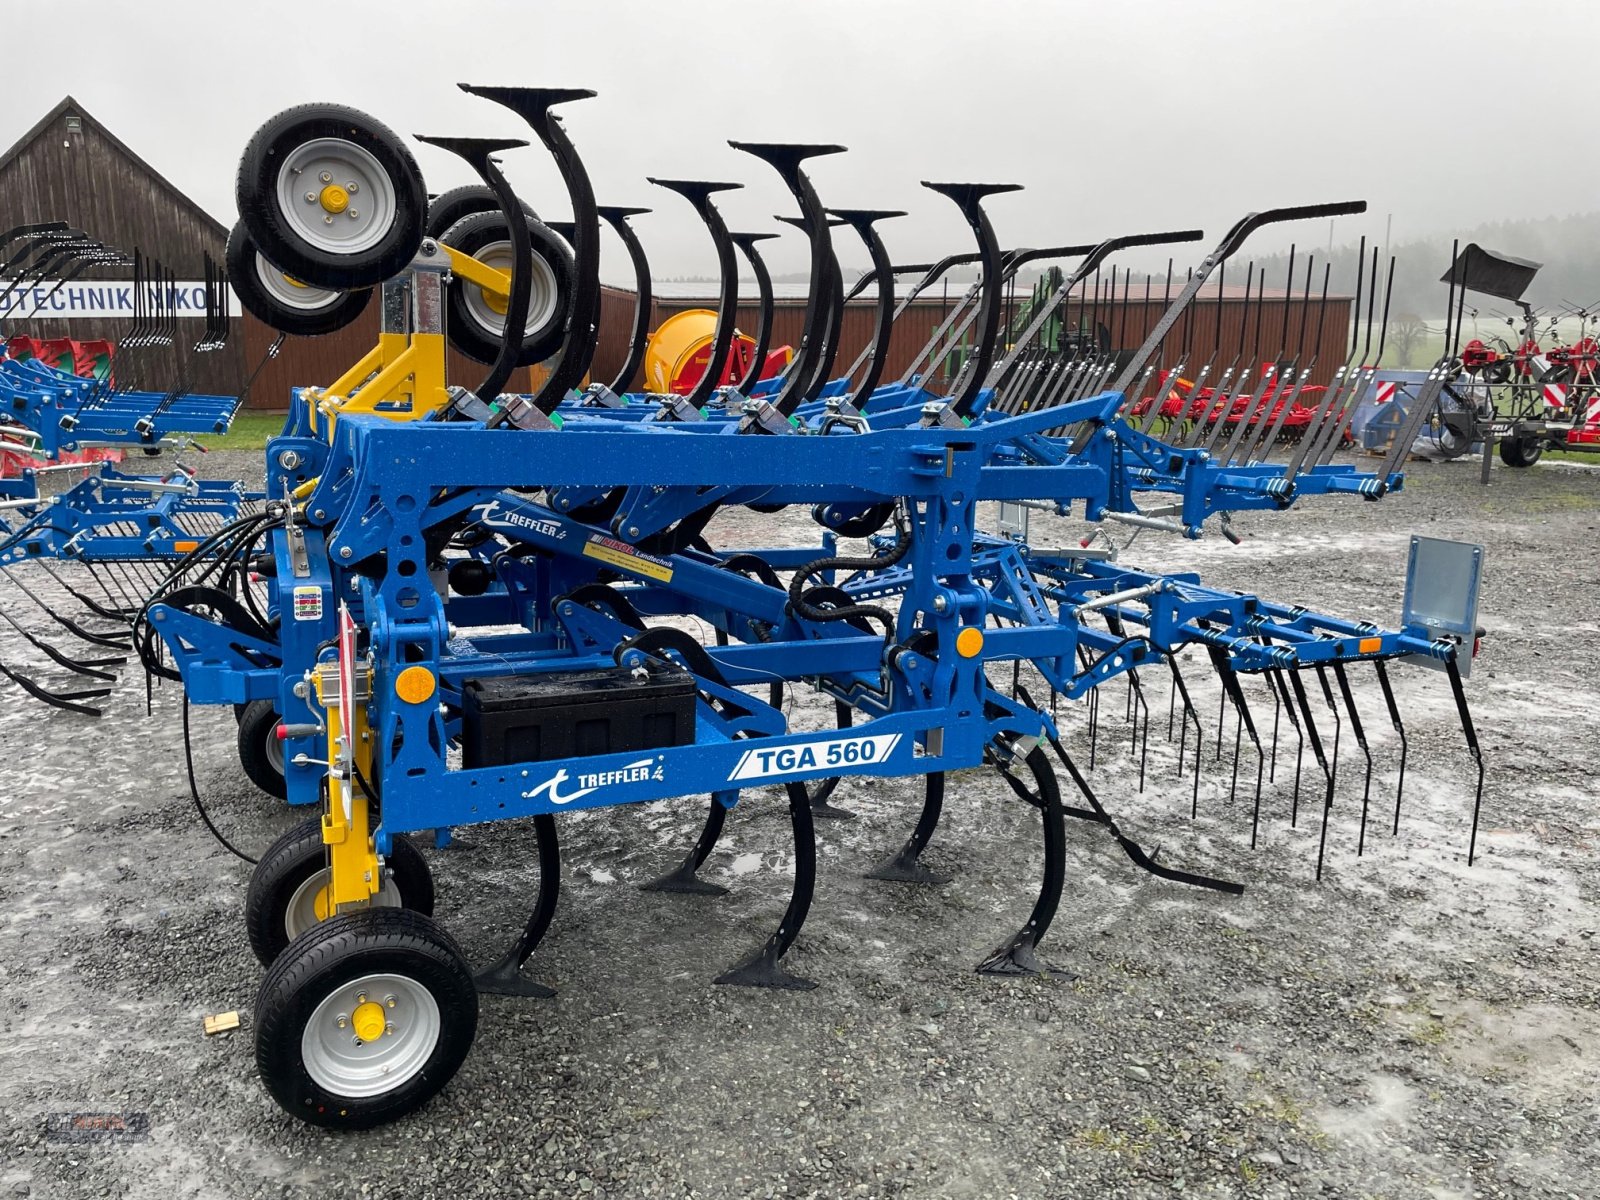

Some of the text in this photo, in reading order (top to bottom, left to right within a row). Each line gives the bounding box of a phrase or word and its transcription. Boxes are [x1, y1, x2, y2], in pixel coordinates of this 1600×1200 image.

[505, 511, 557, 537] TREFFLER
[600, 537, 635, 555] NIKOL
[635, 550, 674, 568] Landtechnik
[756, 739, 876, 773] TGA 560
[578, 767, 650, 788] TREFFLER
